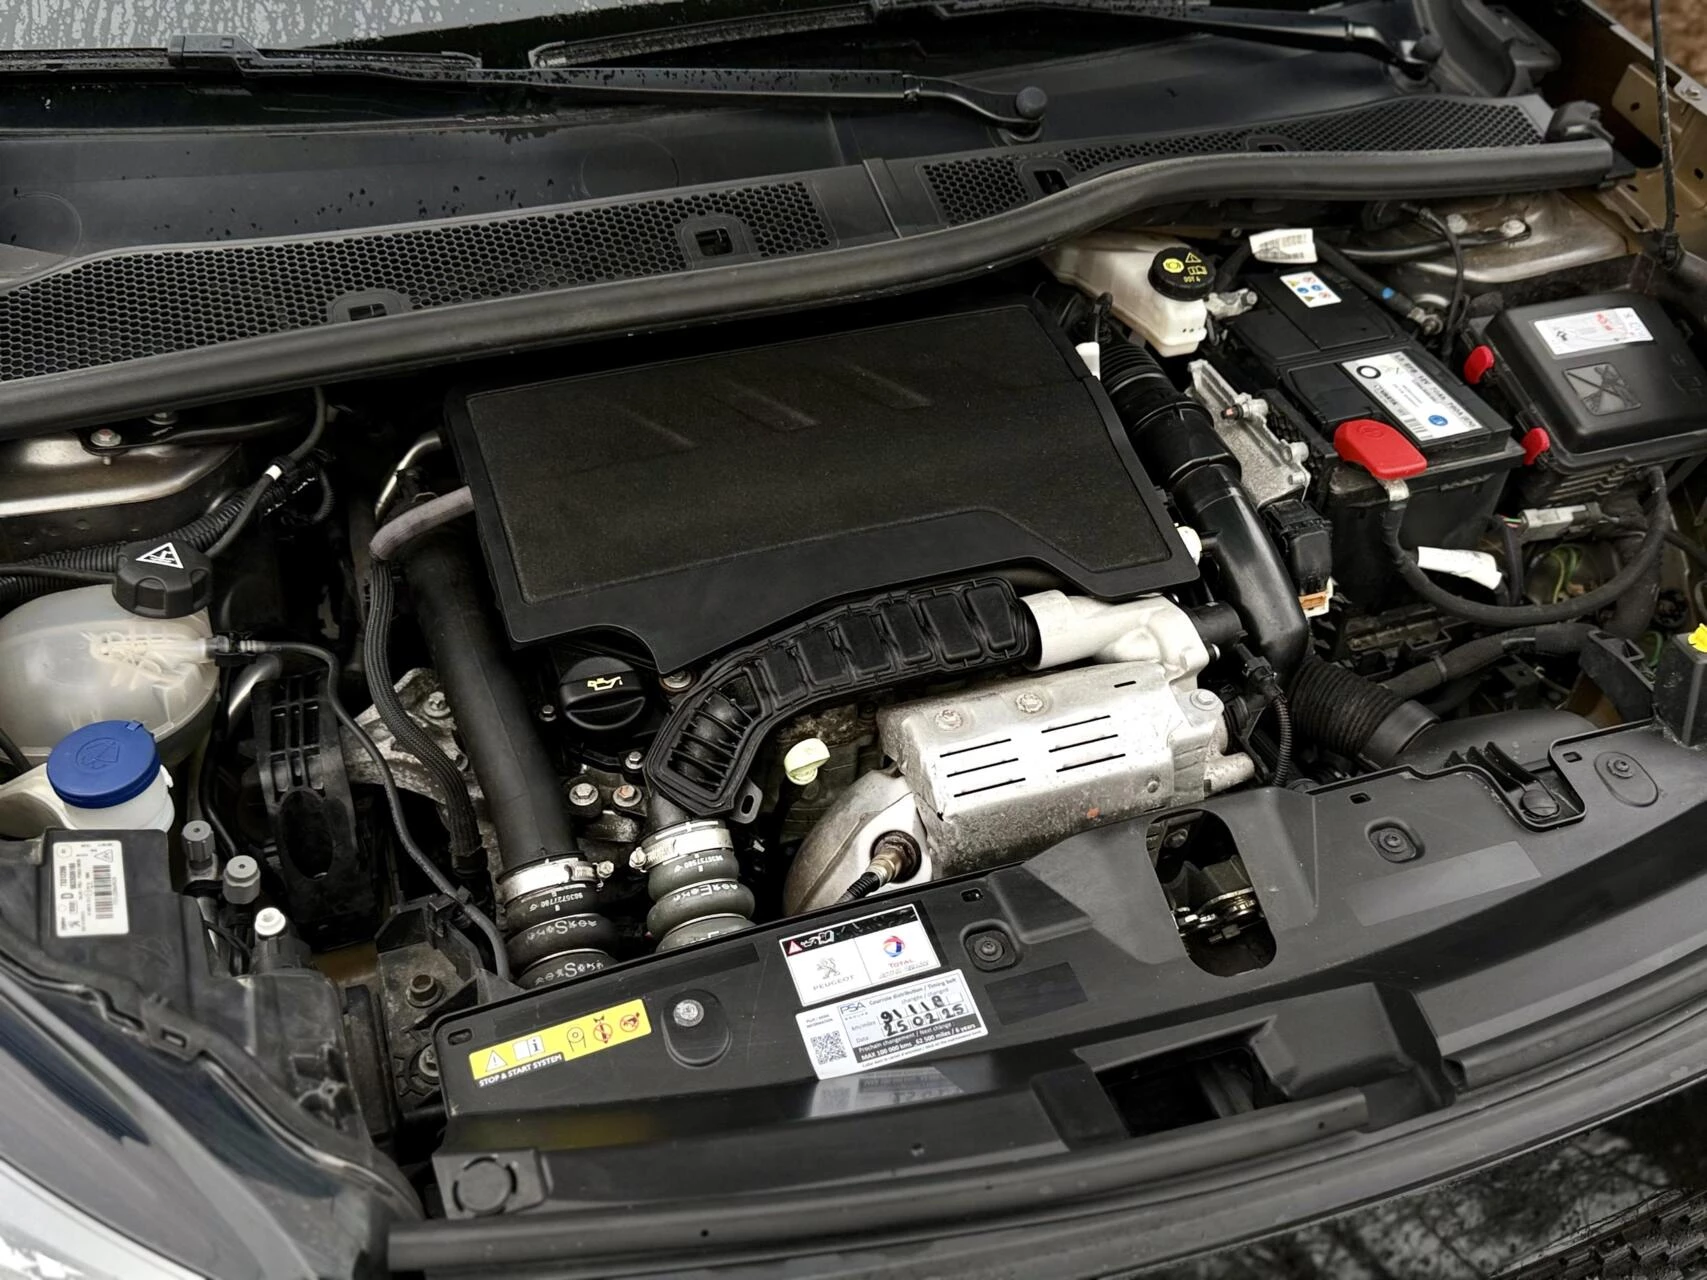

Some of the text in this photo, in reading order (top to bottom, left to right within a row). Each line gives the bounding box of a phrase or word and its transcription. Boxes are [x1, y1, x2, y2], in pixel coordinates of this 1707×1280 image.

[564, 962, 578, 977] S
[889, 959, 914, 968] TOTAL
[812, 974, 855, 990] PEUGEOT
[840, 1000, 865, 1014] PSA
[858, 1042, 881, 1052] Prochain
[881, 1033, 916, 1047] changement
[860, 1051, 876, 1060] MAX
[876, 1047, 888, 1056] 100
[887, 1044, 899, 1053] 000
[899, 1040, 912, 1049] kms
[934, 1029, 951, 1038] miles
[959, 1023, 976, 1032] years
[479, 1054, 562, 1087] STOP & START SYSTEM
